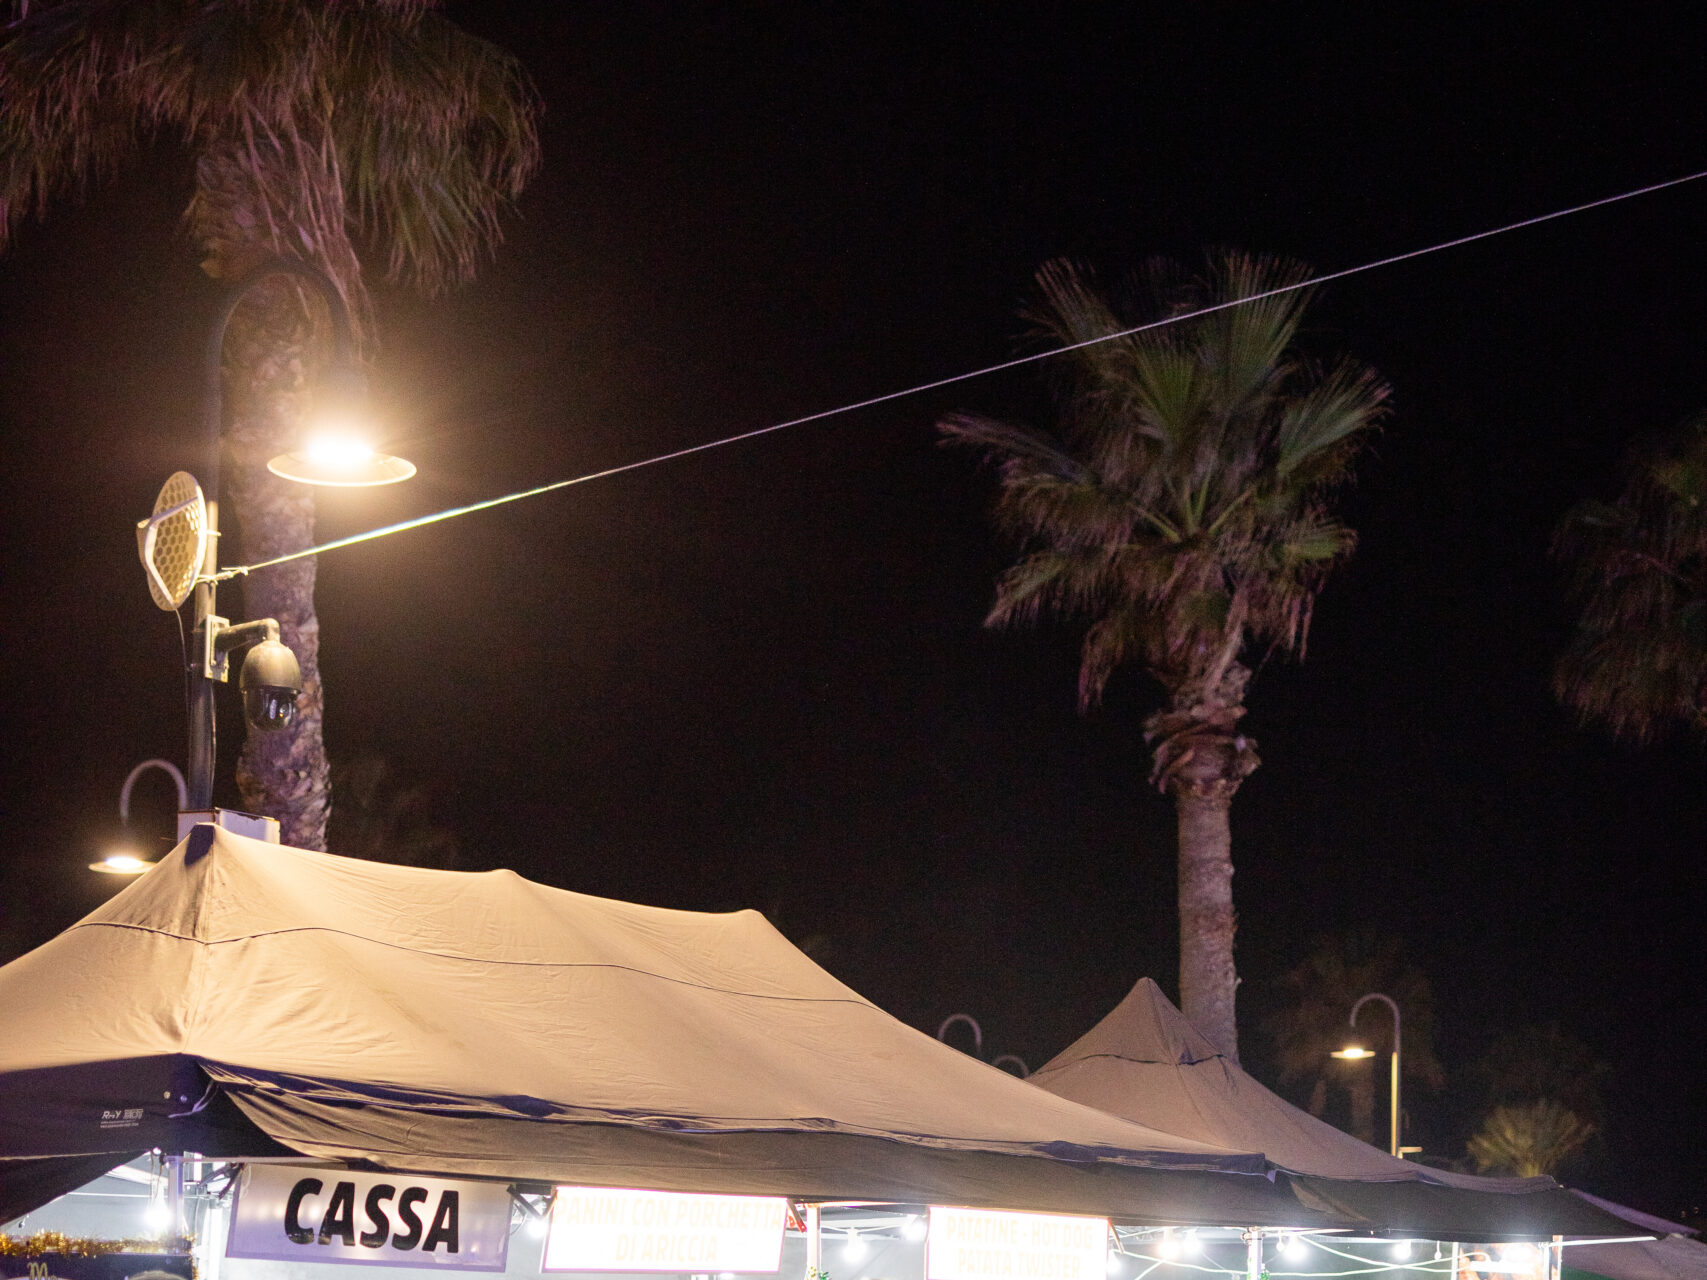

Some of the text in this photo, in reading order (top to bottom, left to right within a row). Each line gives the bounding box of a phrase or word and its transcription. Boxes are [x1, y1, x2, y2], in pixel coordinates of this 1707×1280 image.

[284, 1177, 459, 1254] CASSA
[554, 1196, 784, 1230] PANINI CON PORCHETTA
[615, 1233, 719, 1263] DI ARICCIA
[945, 1215, 1019, 1245] PATATINE
[1031, 1221, 1059, 1247] HOT
[1063, 1223, 1093, 1249] DOG
[957, 1247, 1081, 1280] PATATA TWISTER
